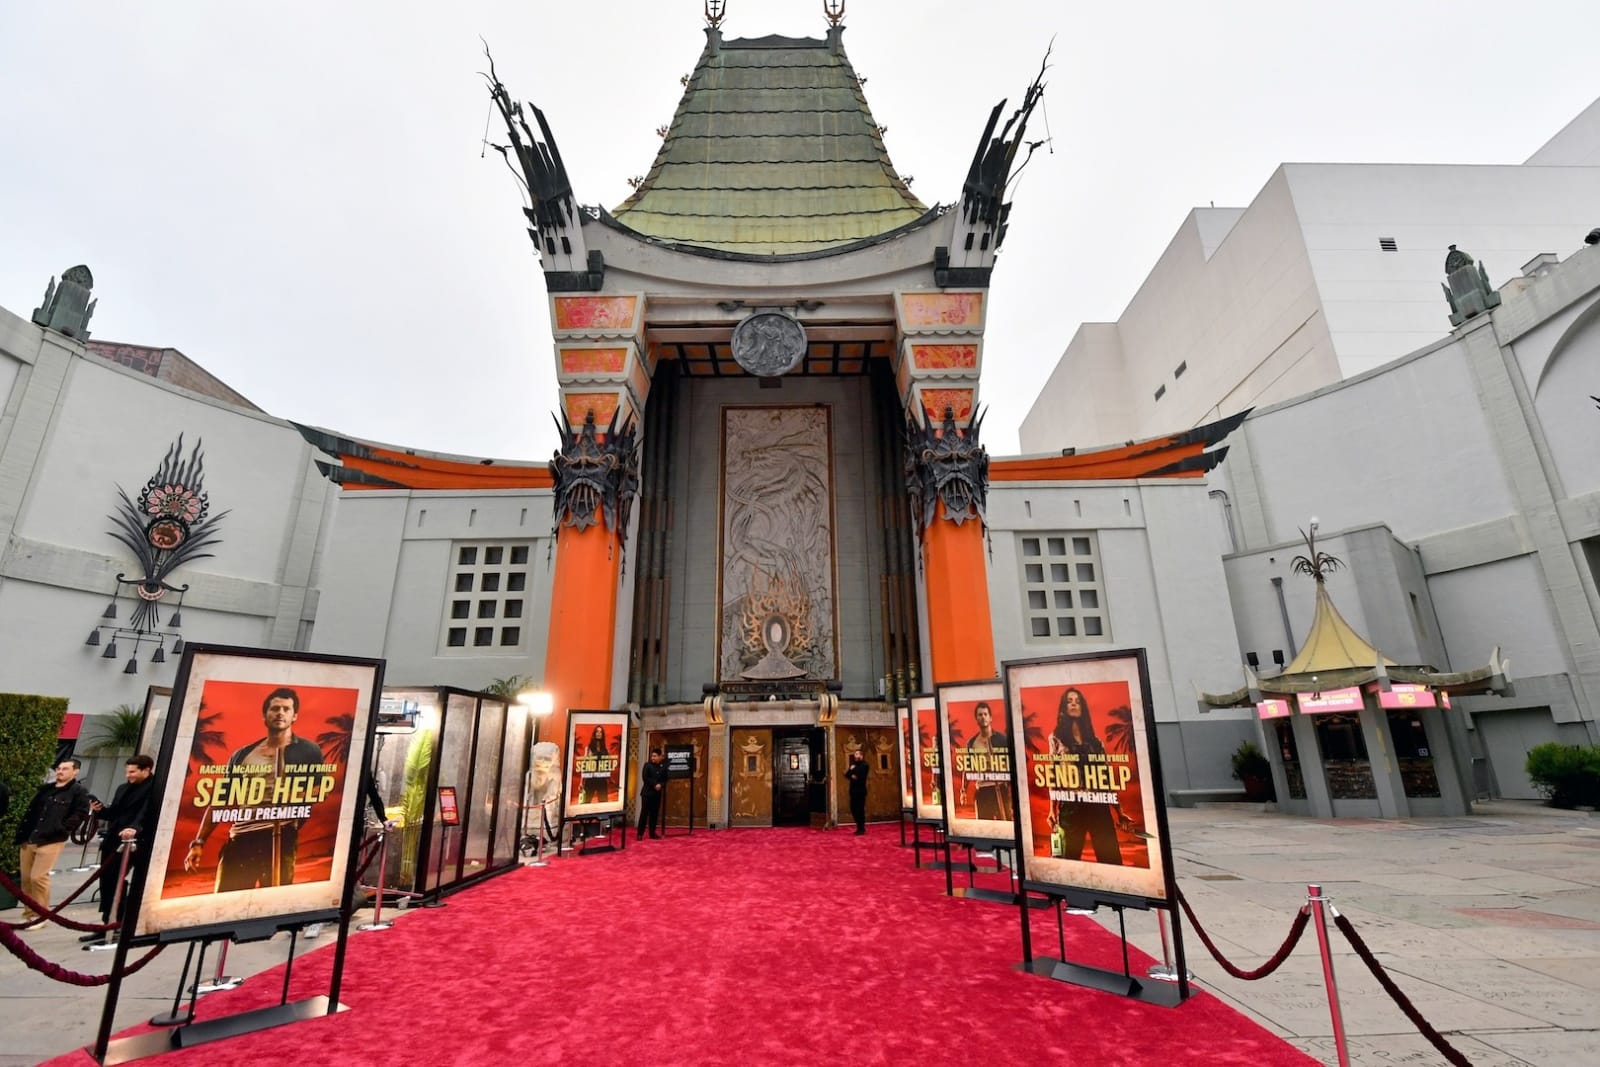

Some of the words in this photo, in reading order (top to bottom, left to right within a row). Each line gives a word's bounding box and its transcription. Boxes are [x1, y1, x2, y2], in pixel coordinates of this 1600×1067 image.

[200, 764, 230, 774] RACHEL
[285, 764, 308, 773] DYLAN
[309, 763, 337, 773] O'BRIEN
[575, 760, 597, 773] SEND
[598, 759, 618, 771] HELP
[956, 755, 987, 772] SEND
[990, 755, 1010, 772] HE
[1033, 763, 1080, 789] SEND
[1084, 764, 1131, 791] HELP
[193, 777, 266, 807] SEND
[271, 775, 335, 804] HELP
[1049, 790, 1075, 802] WORLD
[1077, 791, 1119, 804] PREMIERE
[212, 808, 253, 823] WORLD
[255, 805, 311, 821] PREMIERE
